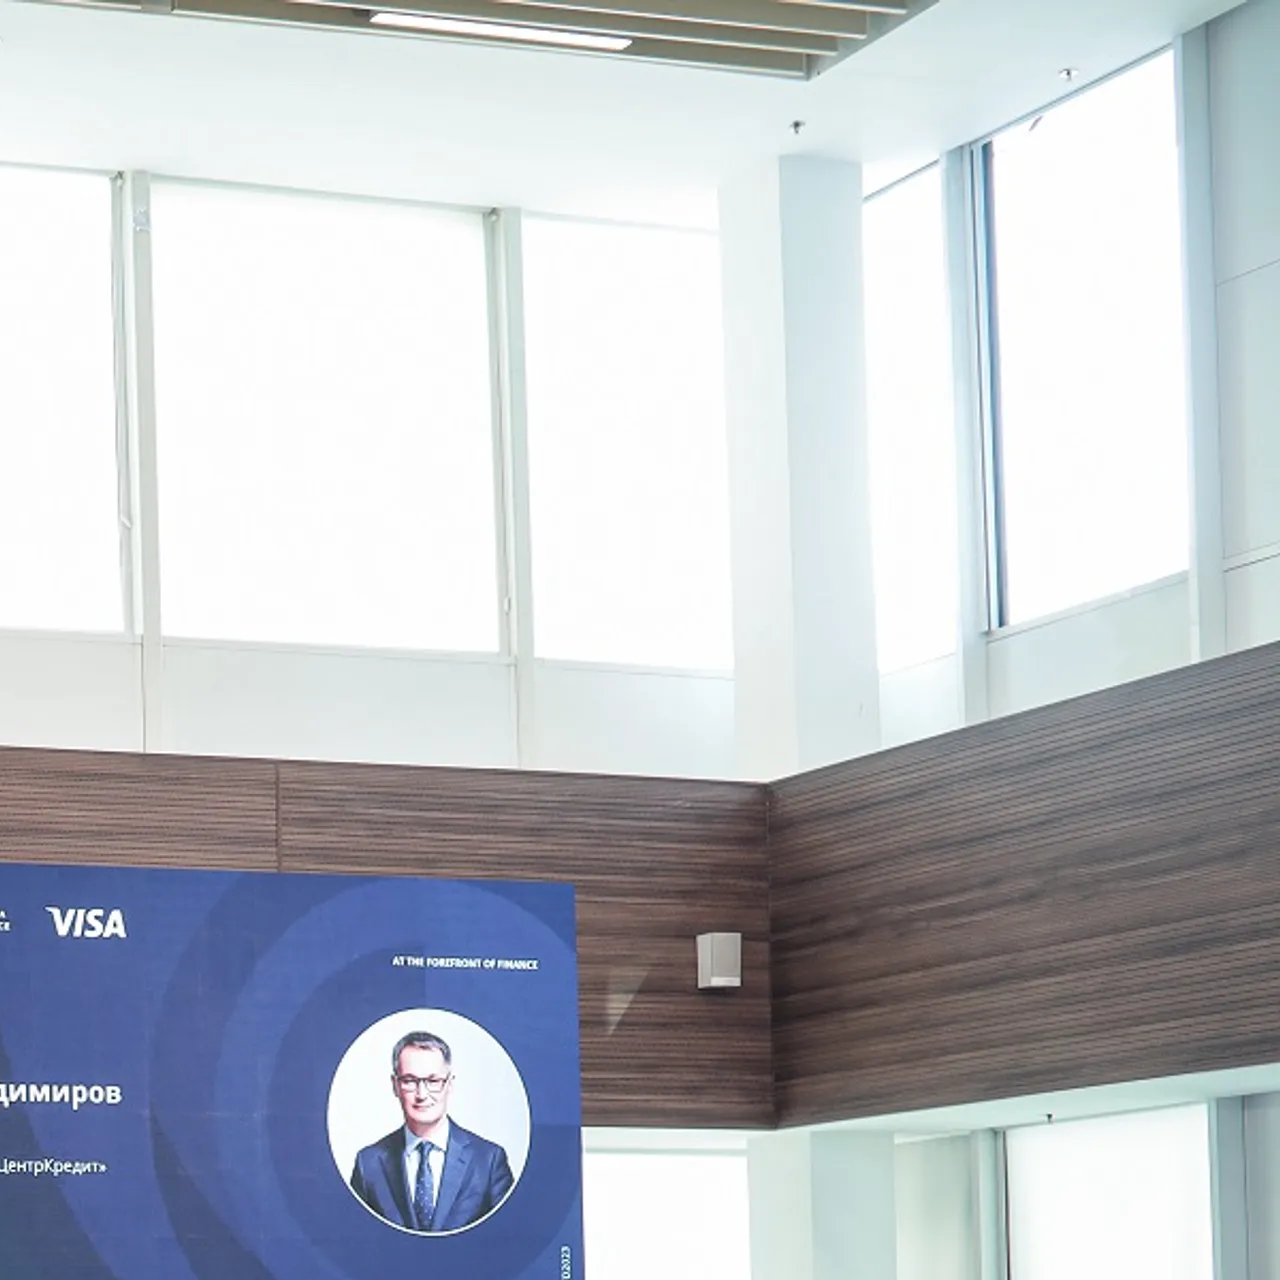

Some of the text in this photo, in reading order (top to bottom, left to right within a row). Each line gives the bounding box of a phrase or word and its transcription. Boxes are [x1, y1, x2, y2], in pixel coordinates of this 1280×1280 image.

[45, 907, 127, 938] VISA
[392, 956, 539, 970] AT THE FOREFRONT OF FINANCE
